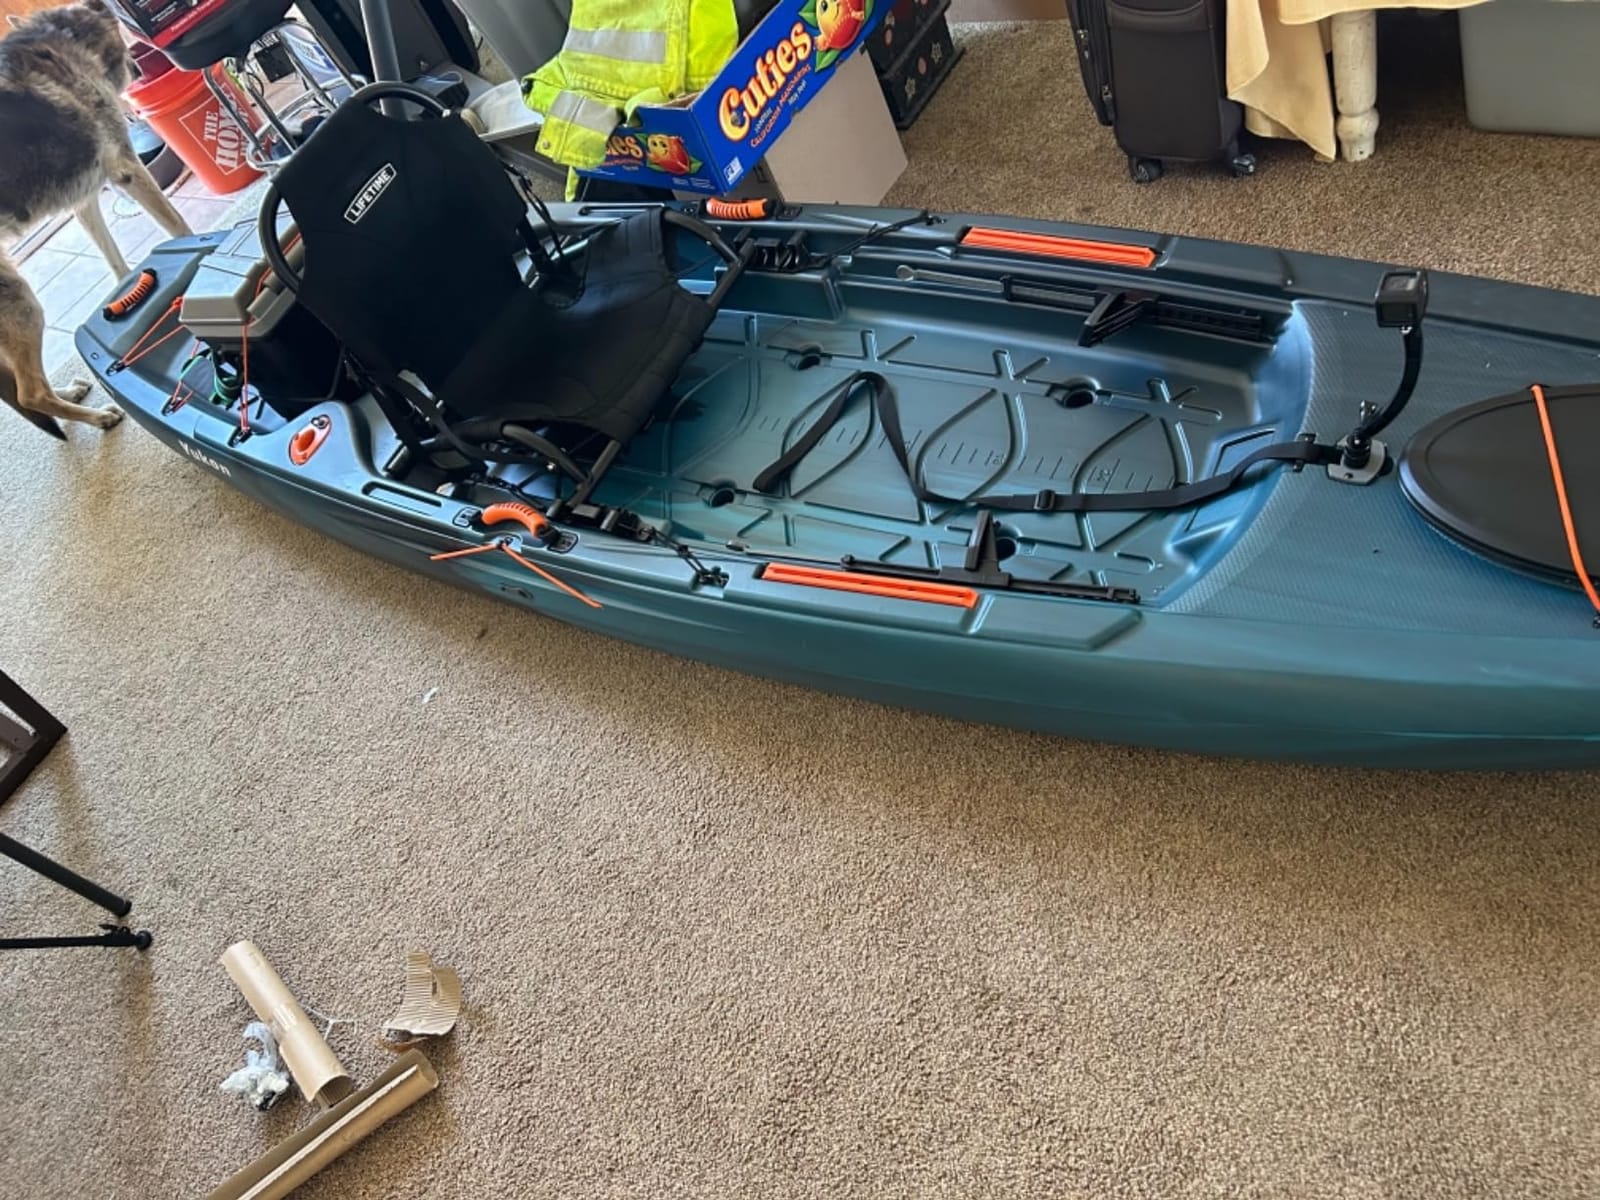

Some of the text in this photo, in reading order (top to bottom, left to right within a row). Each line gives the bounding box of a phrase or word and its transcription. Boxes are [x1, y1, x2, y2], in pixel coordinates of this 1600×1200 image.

[719, 22, 812, 141] Cuties
[204, 110, 218, 141] THE
[350, 170, 391, 216] LIFETIME
